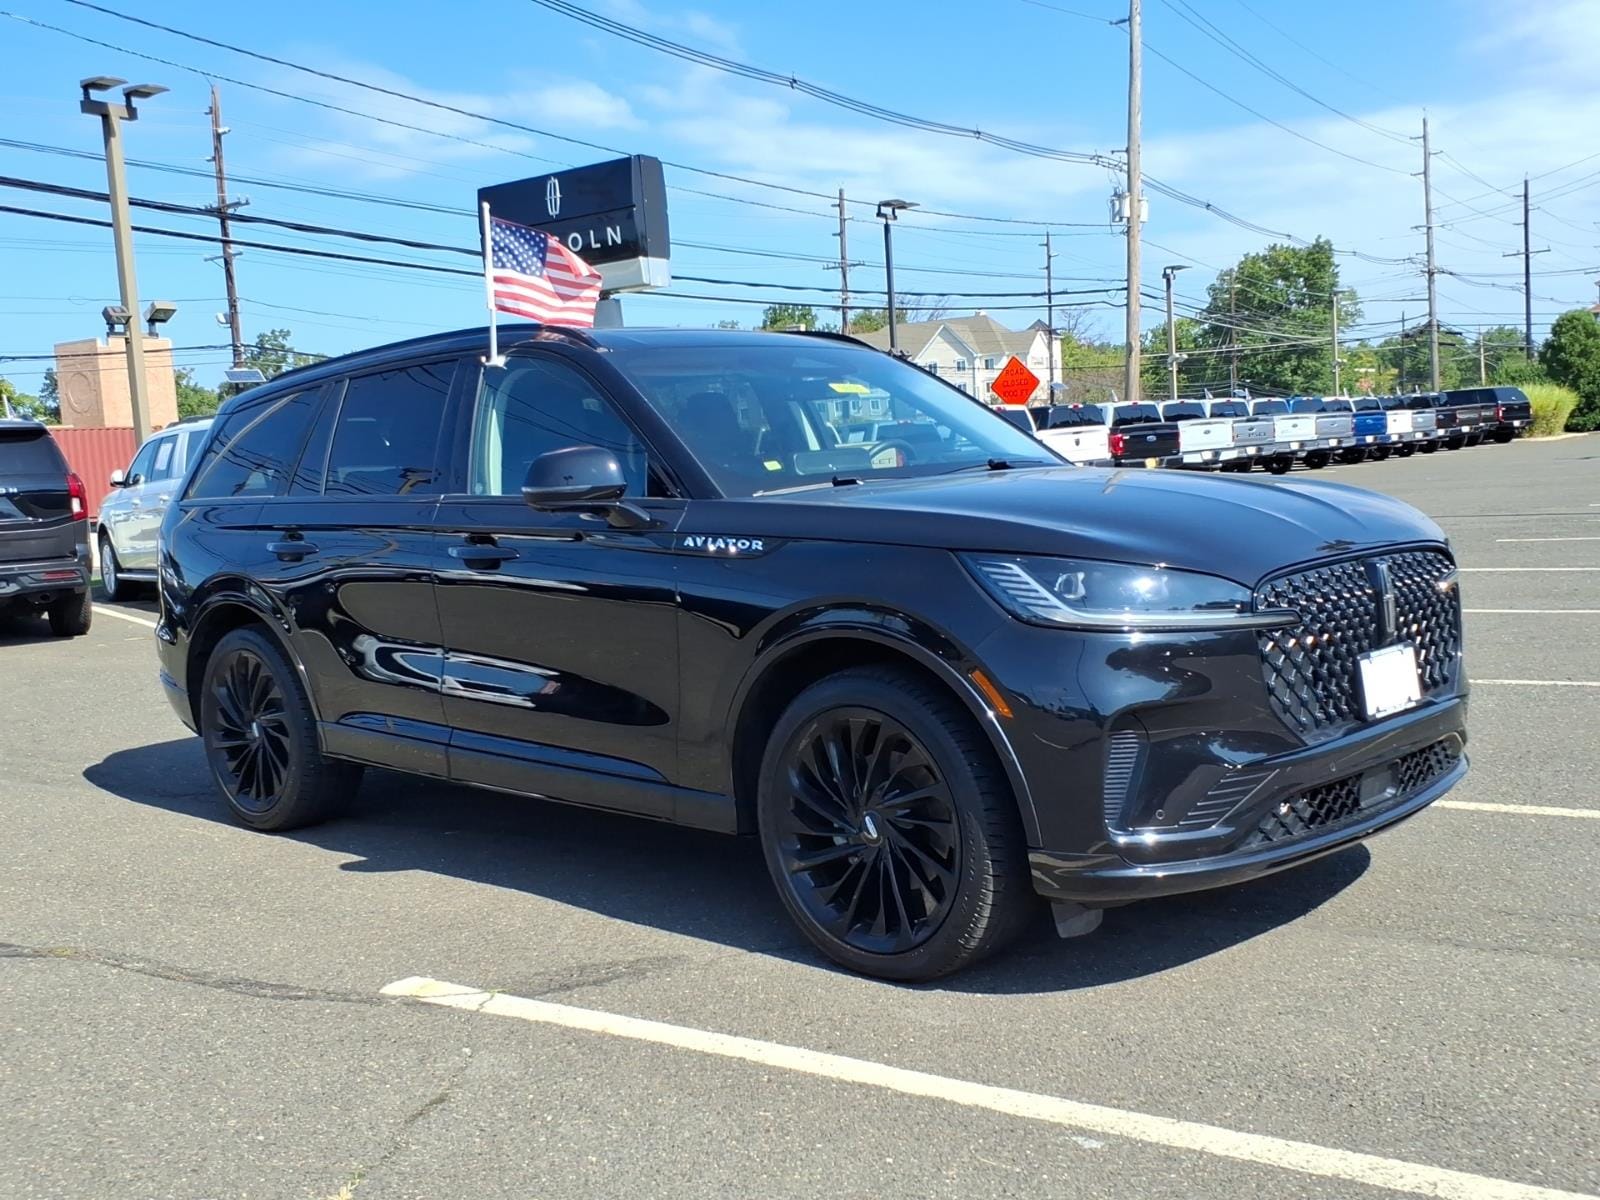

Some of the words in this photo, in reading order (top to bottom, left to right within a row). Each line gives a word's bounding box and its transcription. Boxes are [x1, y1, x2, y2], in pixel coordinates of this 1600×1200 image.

[553, 225, 622, 252] OLN
[1005, 367, 1025, 376] ROAD
[1002, 378, 1029, 388] CLOSED
[683, 536, 763, 552] AVIATOR
